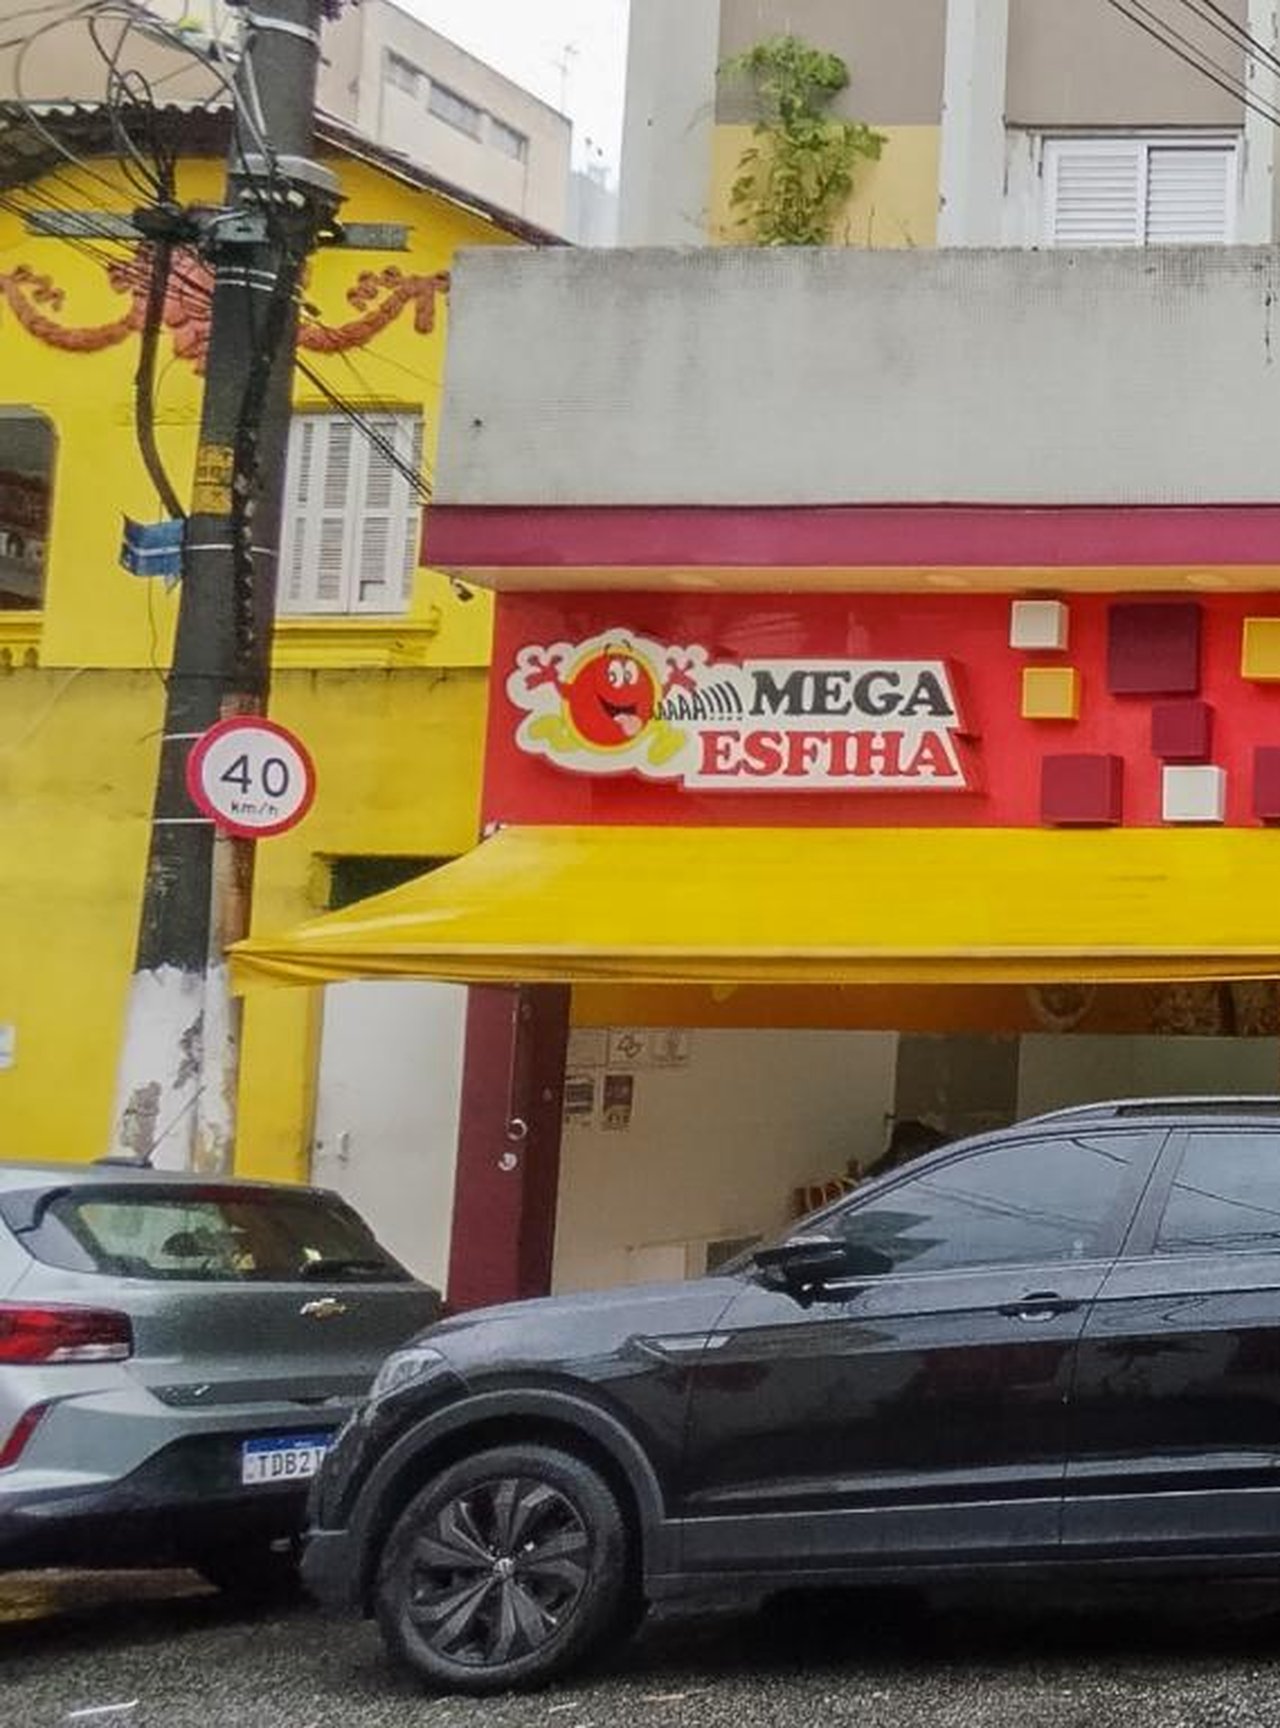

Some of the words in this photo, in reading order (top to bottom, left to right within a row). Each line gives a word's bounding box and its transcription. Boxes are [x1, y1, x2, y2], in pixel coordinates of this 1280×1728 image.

[750, 670, 955, 717] MEGA
[219, 753, 290, 798] 40
[698, 730, 957, 777] ESFIHA
[230, 800, 279, 817] km/h
